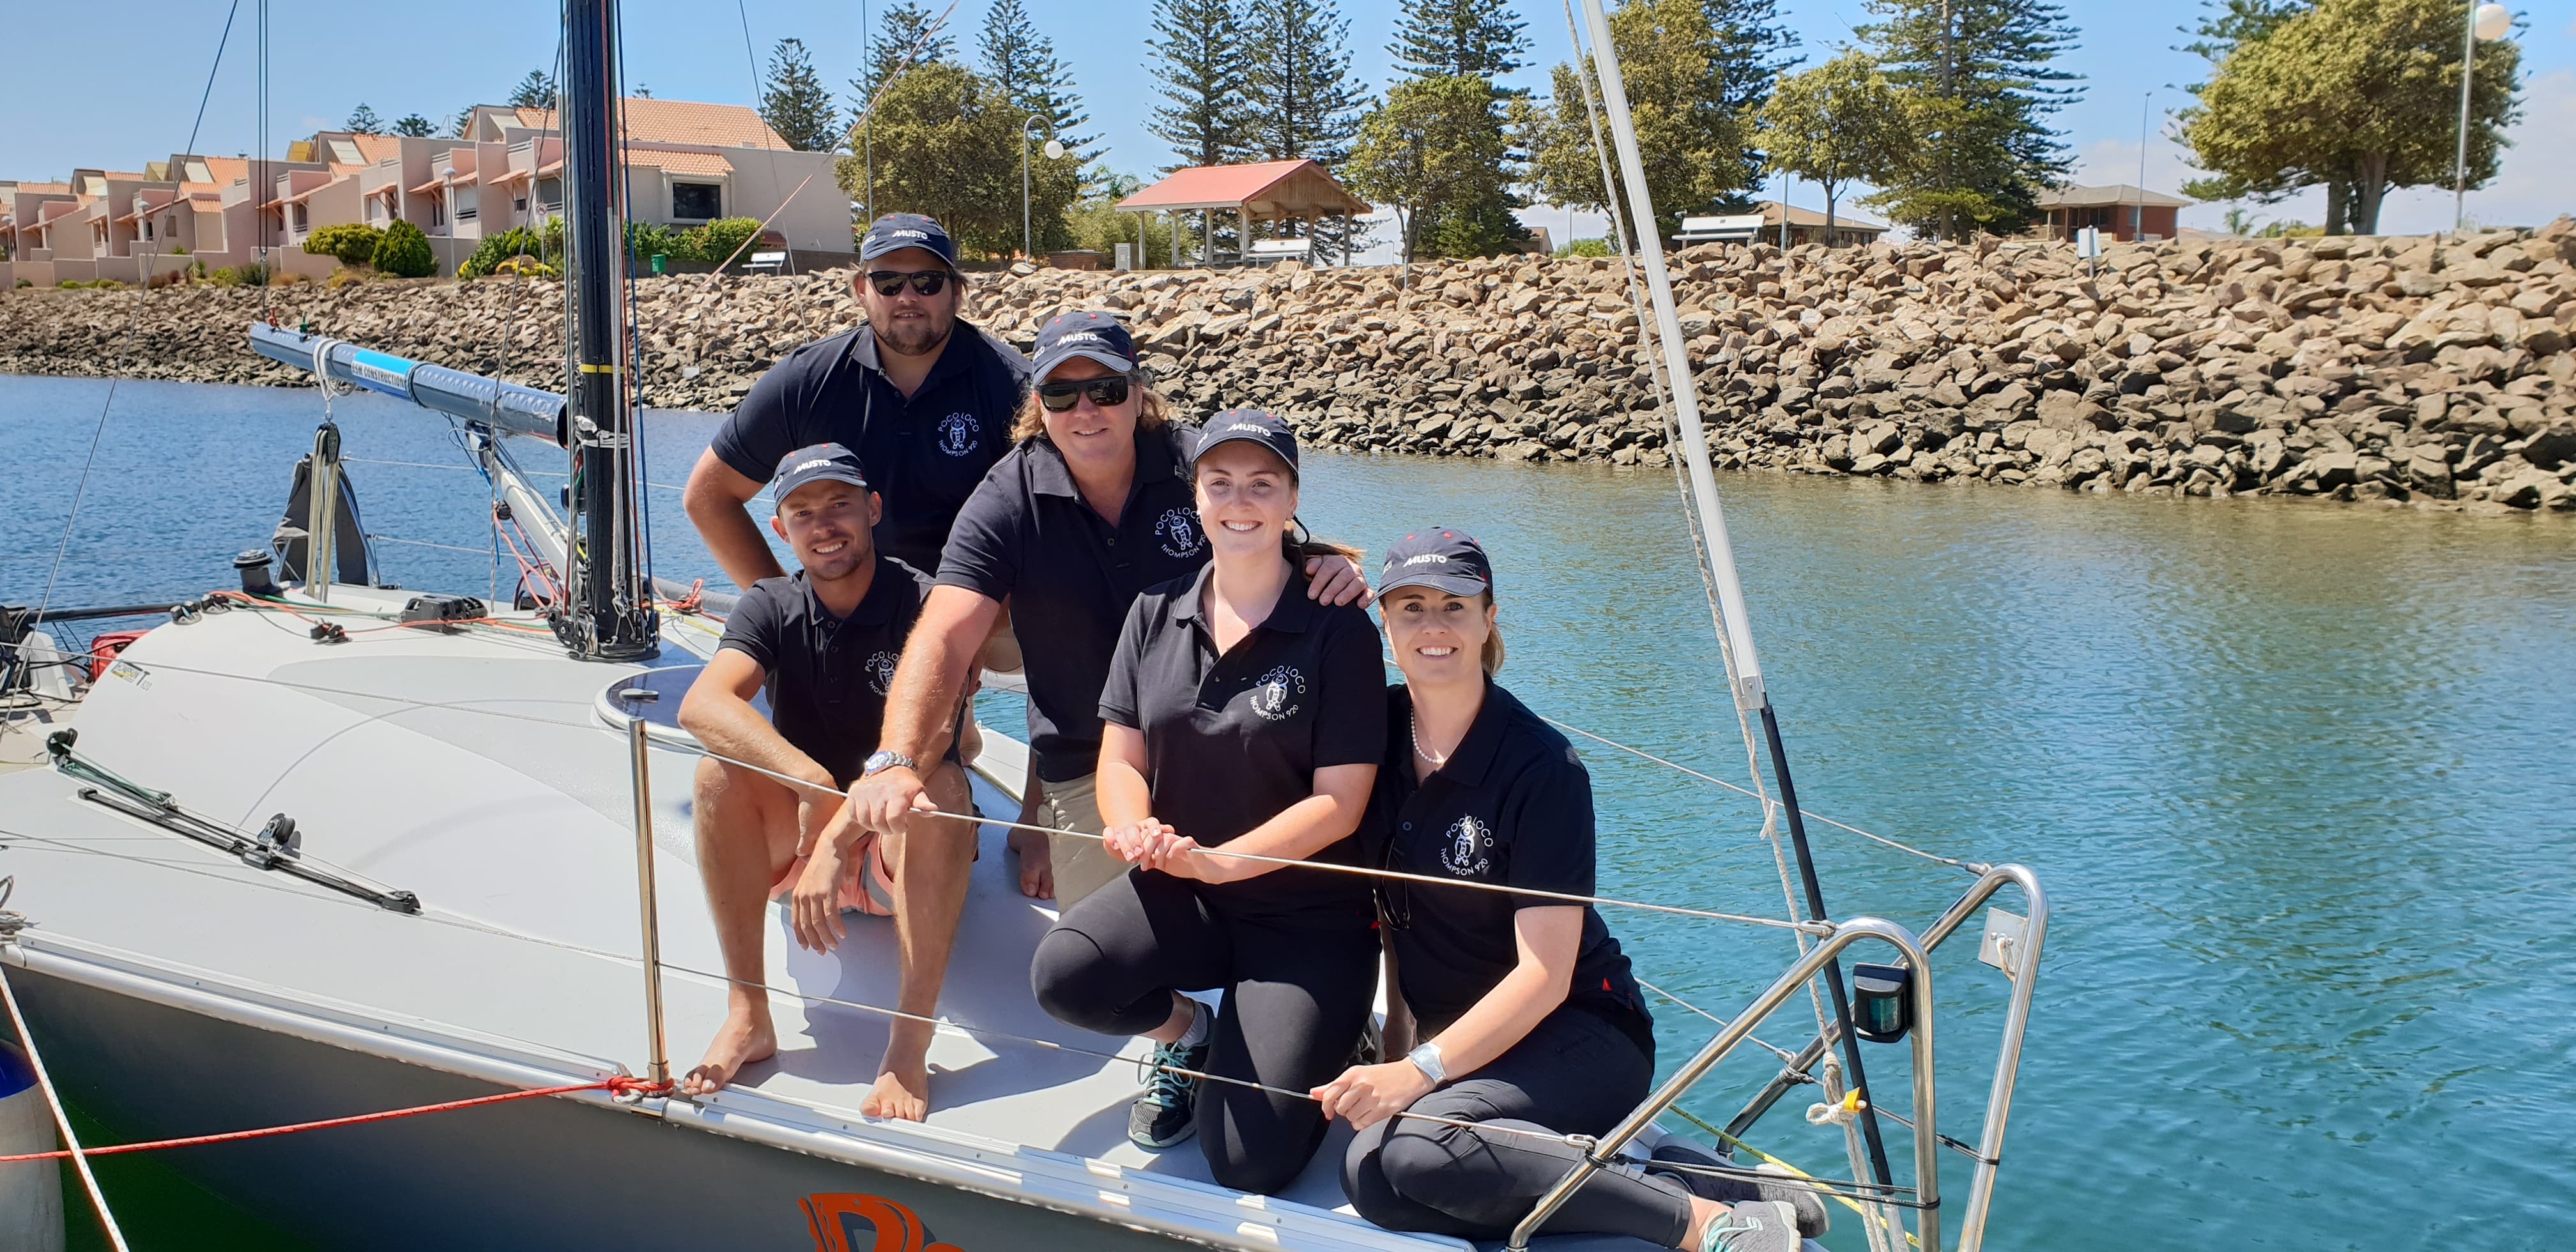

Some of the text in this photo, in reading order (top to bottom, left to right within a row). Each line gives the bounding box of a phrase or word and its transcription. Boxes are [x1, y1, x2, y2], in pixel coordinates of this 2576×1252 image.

[892, 229, 928, 240] MUSTO
[1057, 333, 1098, 346] MUSTO
[938, 413, 979, 432] POCO LOCO
[1227, 423, 1271, 437] MUSTO
[939, 439, 969, 456] THOMPSON
[793, 459, 831, 475] MUSTO
[1155, 509, 1174, 535] POCO
[1161, 544, 1200, 558] THOMPSON
[1402, 554, 1447, 567] MUSTO
[864, 651, 899, 672] POCO LO
[1255, 666, 1306, 694] POCO LOCO
[1250, 695, 1299, 721] THOMPSON 920
[1446, 816, 1493, 847] POCO LOCO
[1441, 847, 1488, 876] THOMPSON 920
